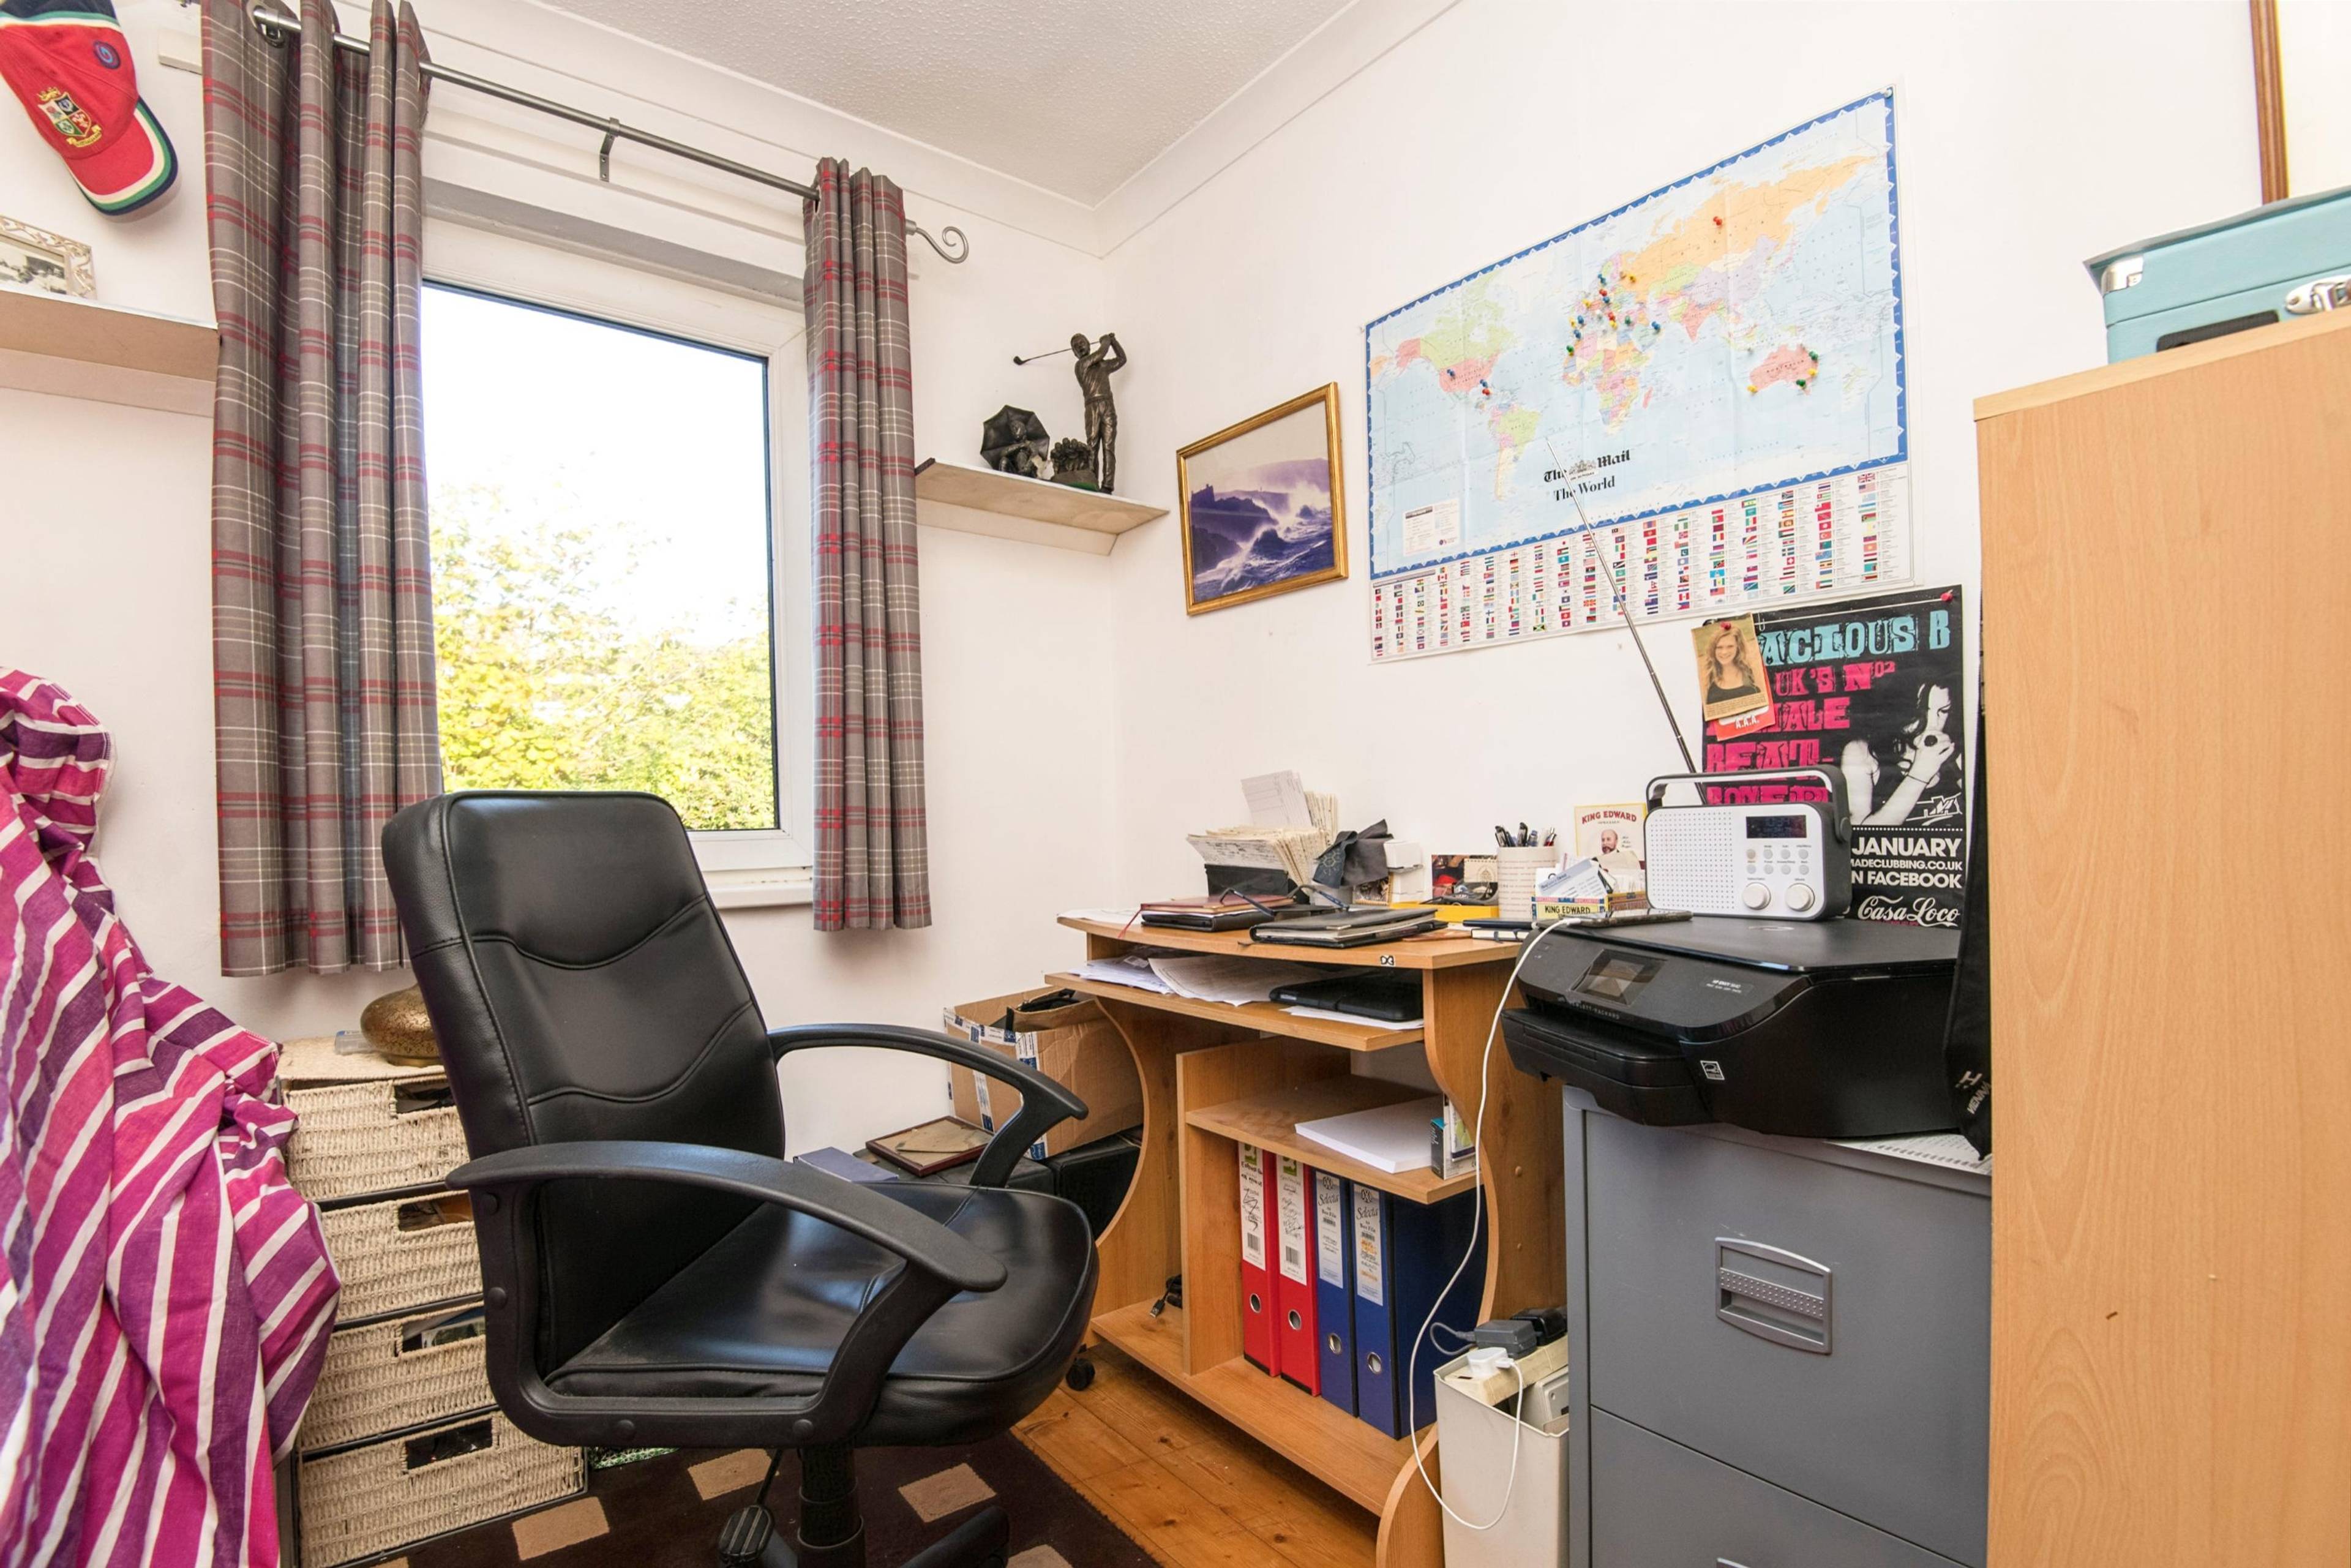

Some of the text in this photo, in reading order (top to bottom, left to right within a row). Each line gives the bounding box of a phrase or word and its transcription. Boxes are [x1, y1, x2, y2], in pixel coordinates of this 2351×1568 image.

[1597, 449, 1630, 468] Mail
[1578, 476, 1615, 494] World
[1756, 610, 1951, 666] ACIOUS B
[1775, 666, 1835, 696] UK'S
[1735, 715, 1760, 729] A.A.A.
[1581, 812, 1601, 824] KING
[1603, 811, 1637, 822] EDWARD
[1851, 836, 1962, 857] JANUARY
[1851, 871, 1963, 888] N FACEBOOK
[1545, 905, 1591, 915] KING EDWARD
[1858, 895, 1960, 928] Casa Loco
